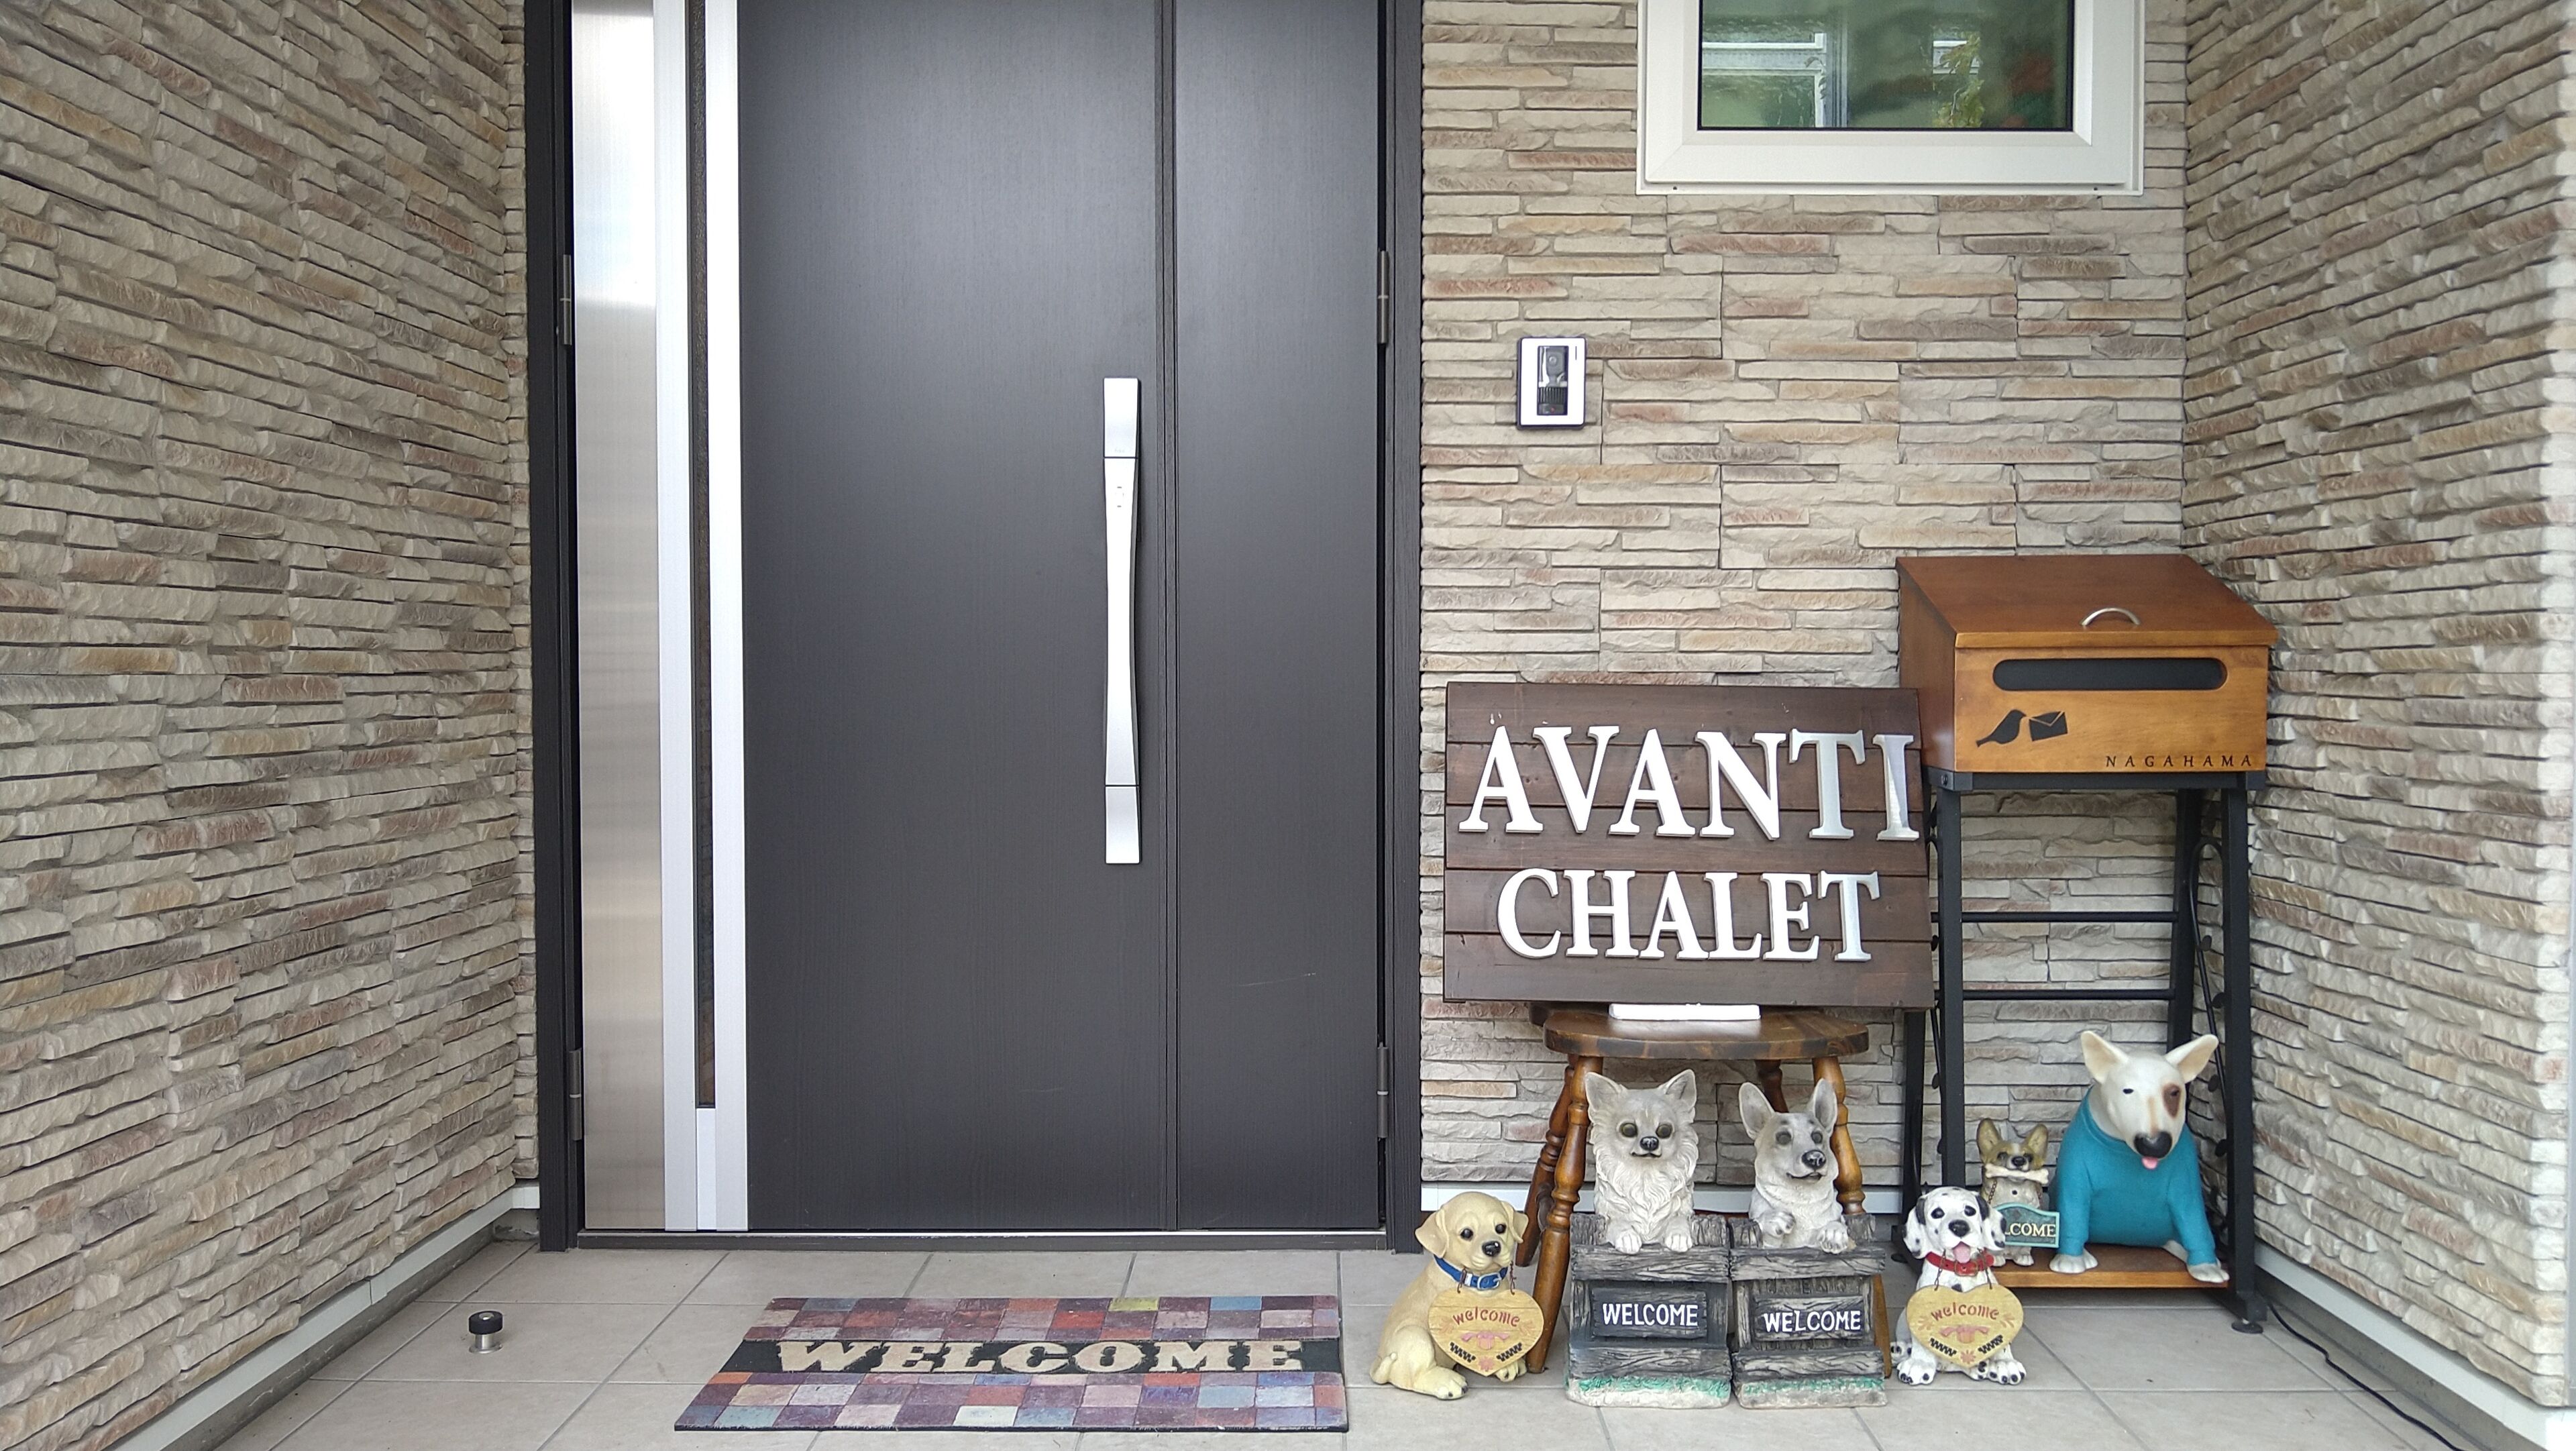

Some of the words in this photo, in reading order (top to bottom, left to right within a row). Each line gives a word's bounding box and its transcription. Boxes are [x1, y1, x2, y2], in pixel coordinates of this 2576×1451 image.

[2105, 755, 2251, 767] NAGAHAMA
[1458, 724, 1920, 841] AVANTI
[1497, 867, 1880, 963] CHALET
[2004, 1222, 2056, 1238] COME
[1452, 1306, 1520, 1327] welcome
[1601, 1303, 1699, 1326] WELCOME
[1764, 1310, 1862, 1333] WELCOME
[1930, 1302, 2000, 1322] welcome
[776, 1340, 1303, 1373] WELCOME
